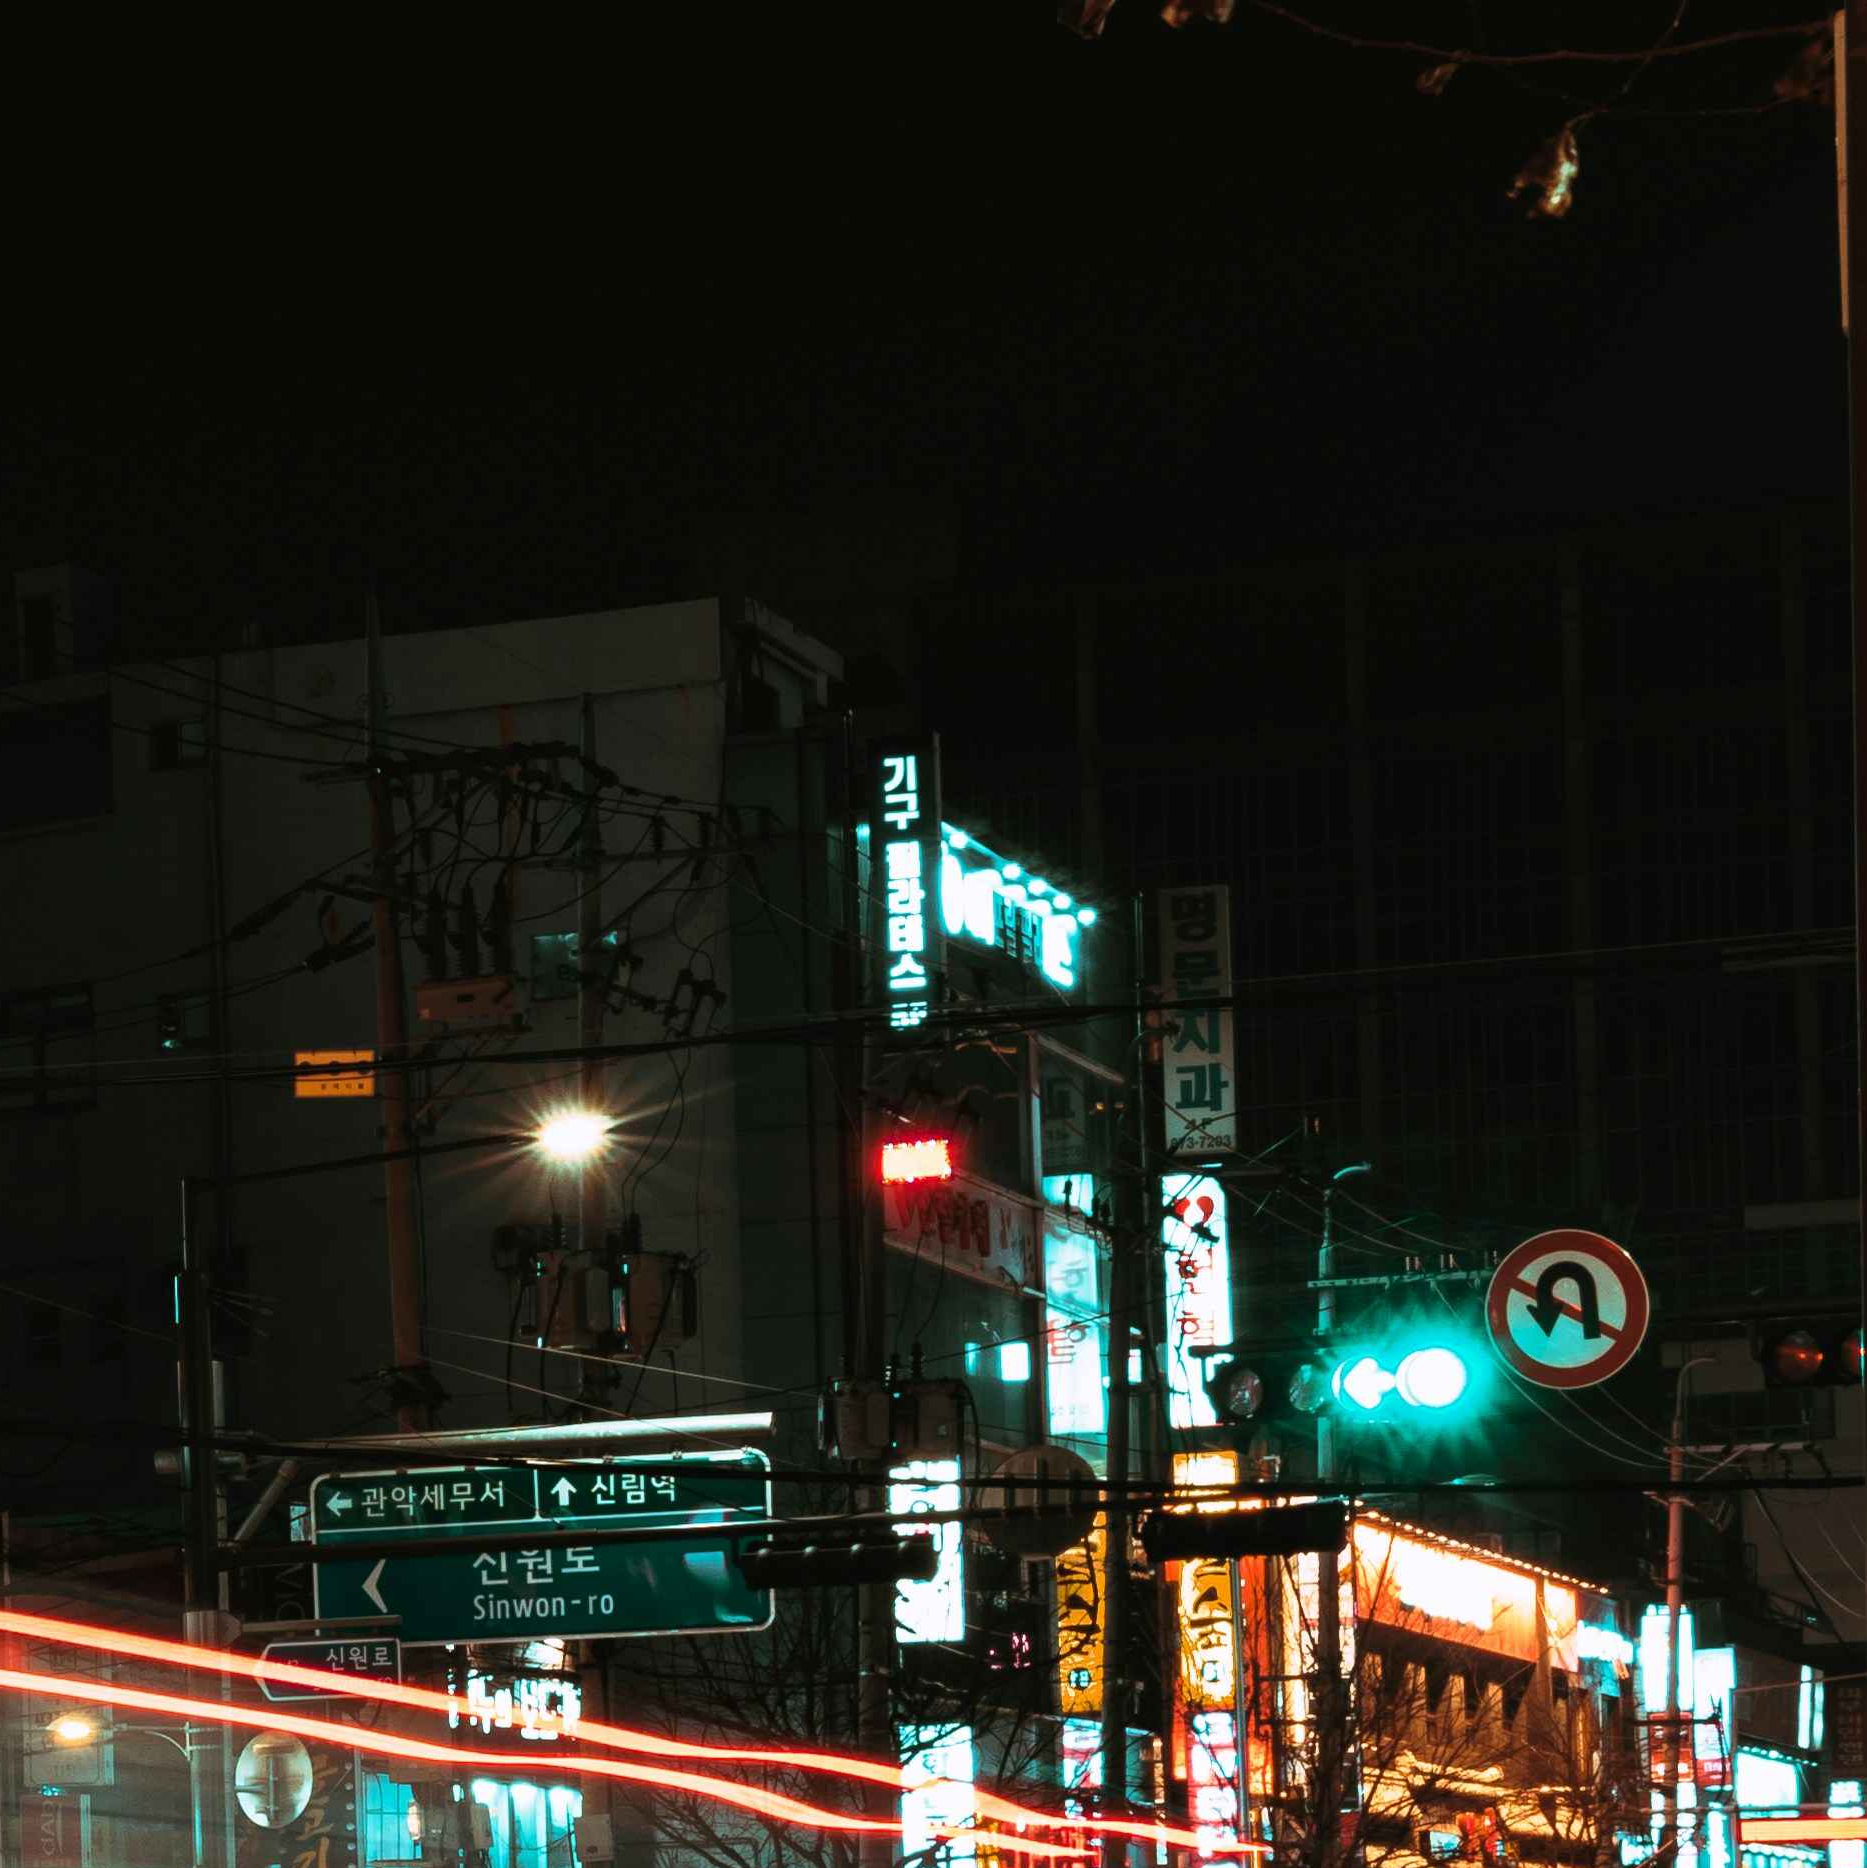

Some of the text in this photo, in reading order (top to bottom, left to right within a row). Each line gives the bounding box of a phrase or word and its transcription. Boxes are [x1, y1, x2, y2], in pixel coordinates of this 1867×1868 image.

[885, 756, 919, 829] 기구
[361, 1481, 506, 1518] 관악세무서
[591, 1473, 677, 1504] 신림역
[473, 1591, 614, 1621] Sinwon-ro
[326, 1645, 393, 1671] 신원로
